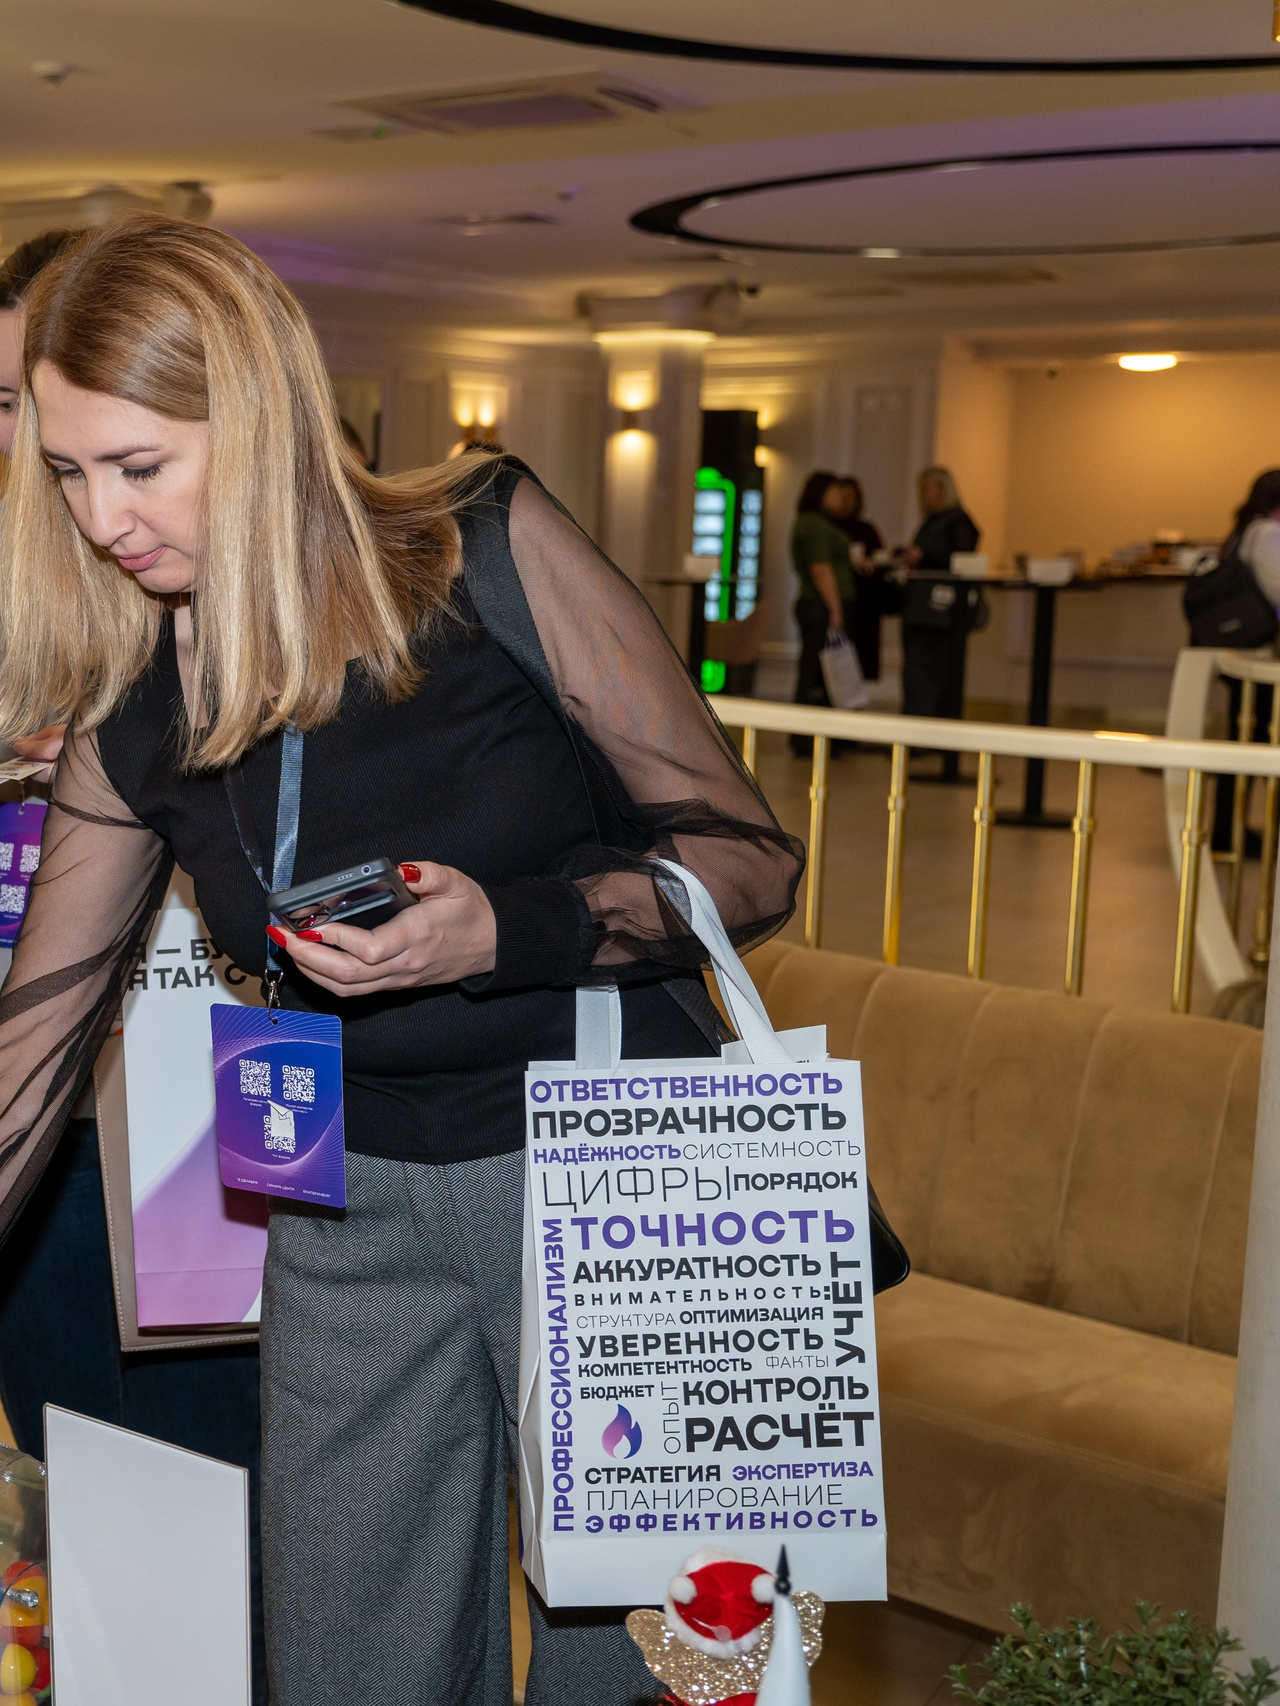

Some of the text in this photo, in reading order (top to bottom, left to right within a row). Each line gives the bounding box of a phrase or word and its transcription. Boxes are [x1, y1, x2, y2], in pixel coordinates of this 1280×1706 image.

[129, 968, 148, 991] Я
[153, 965, 215, 989] ТАК
[530, 1072, 843, 1103] ОТВЕТСТВЕННОСТЬ
[532, 1103, 847, 1139] ПРОЗРАЧНОСТЬ
[534, 1140, 861, 1166] НАДЁЖНОСТЬ СИСТЕМНОСТЬ
[543, 1166, 858, 1213] ЦИФРЫ ПОРЯДОК
[570, 1209, 855, 1250] ТОЧНОСТЬ
[572, 1253, 822, 1284] АККУРАТНОСТЬ
[574, 1285, 822, 1307] ВНИМАТЕЛЬНОСТЬ
[823, 1251, 867, 1367] УЧЁТ
[576, 1306, 824, 1330] СТРУКТУРА ОПТИМИЗАЦИЯ
[576, 1328, 824, 1360] УВЕРЕННОСТЬ
[542, 1218, 575, 1532] ПРОФЕССИОНАЛИЗМ
[578, 1355, 829, 1378] КОМПЕТЕНТНОСТЬ ФАКТЫ
[580, 1383, 655, 1401] БЮДЖЕТ
[683, 1376, 870, 1406] КОНТРОЛЬ
[661, 1381, 681, 1454] ОПЫТ
[685, 1402, 875, 1453] РАСЧЁТ
[585, 1461, 875, 1485] СТРАТЕГИЯ ЭКСПЕРТИЗА
[586, 1484, 843, 1511] ПЛАНИРОВАНИЕ
[584, 1509, 879, 1533] ЭФФЕКТИВНОСТЬ
